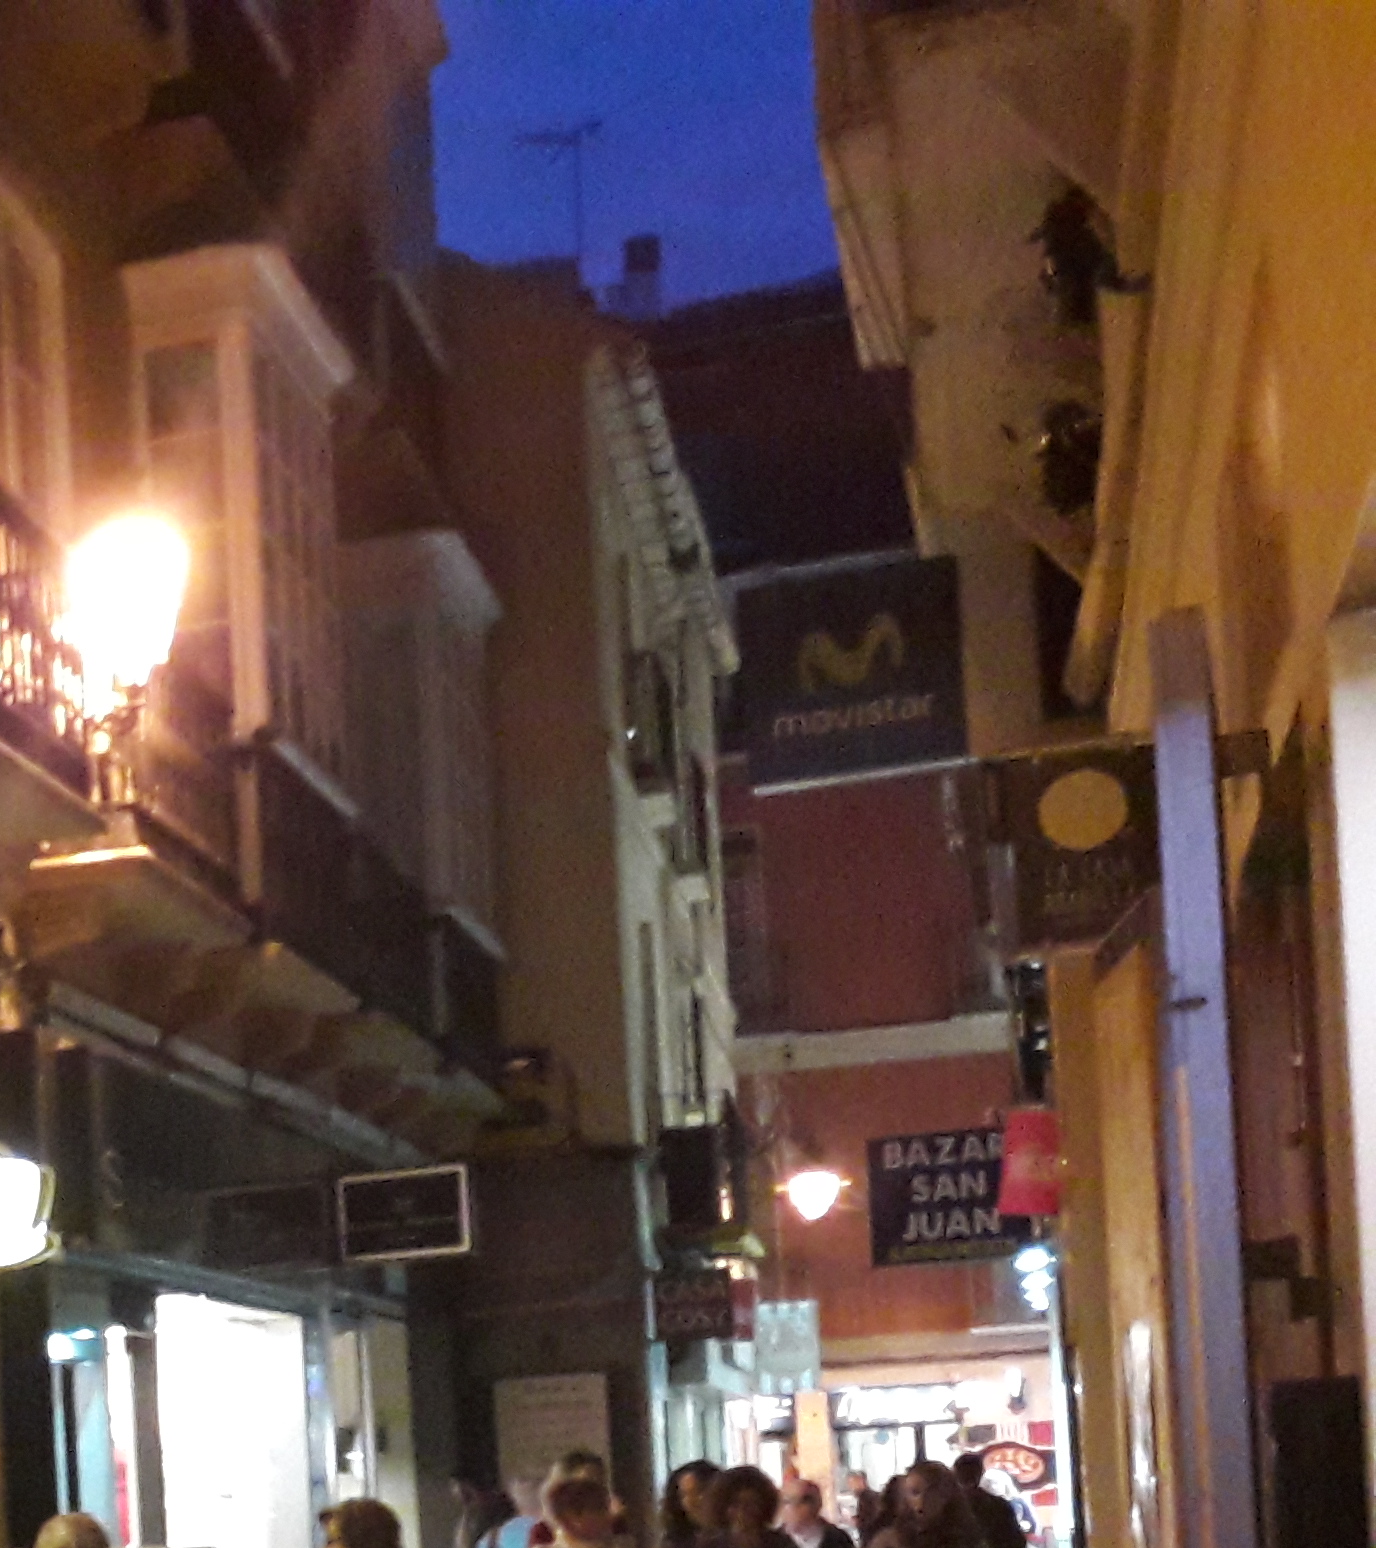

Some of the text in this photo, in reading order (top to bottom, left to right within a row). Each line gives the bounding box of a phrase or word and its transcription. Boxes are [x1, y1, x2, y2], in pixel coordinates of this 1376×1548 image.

[772, 692, 935, 738] movistar
[910, 1169, 988, 1203] SAN
[901, 1206, 1000, 1242] JUAN
